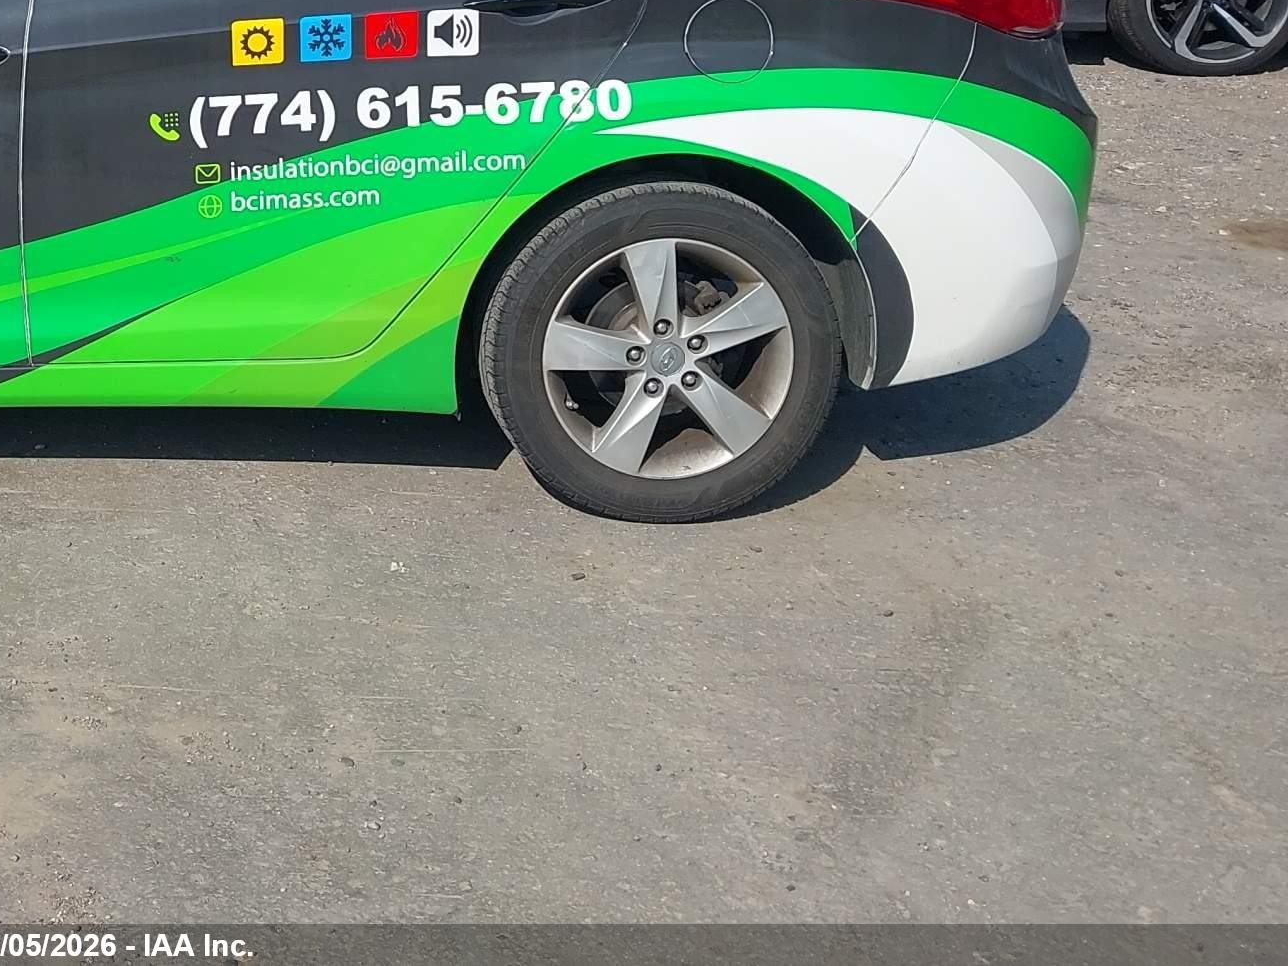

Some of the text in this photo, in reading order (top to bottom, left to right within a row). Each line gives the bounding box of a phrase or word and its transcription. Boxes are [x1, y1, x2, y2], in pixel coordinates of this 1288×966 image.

[189, 79, 633, 149] (774) 615-6780
[230, 151, 526, 182] insulationbci@gmail.com
[230, 187, 380, 213] bcimass.com
